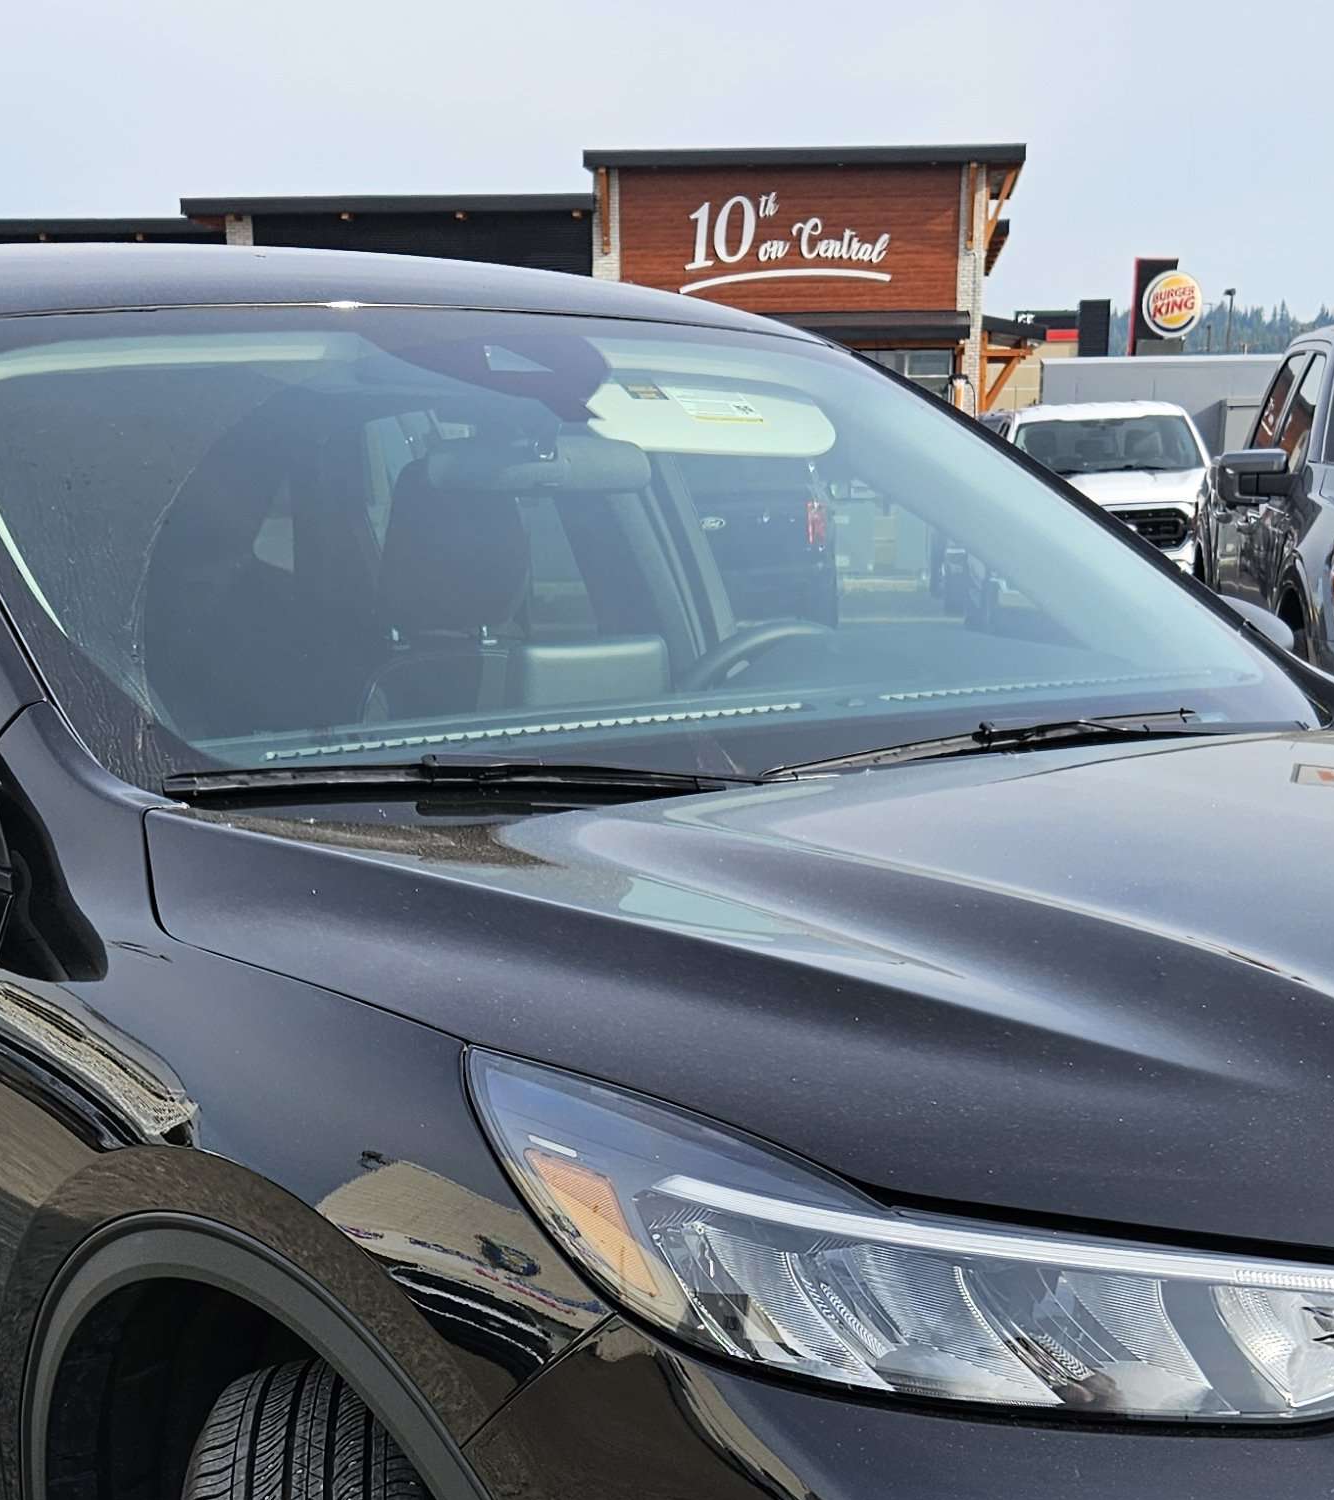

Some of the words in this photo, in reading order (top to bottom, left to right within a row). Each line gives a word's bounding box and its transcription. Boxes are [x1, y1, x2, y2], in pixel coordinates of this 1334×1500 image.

[757, 239, 790, 262] on
[791, 217, 891, 263] Central
[1152, 285, 1196, 303] BURGER
[1152, 296, 1196, 320] KING
